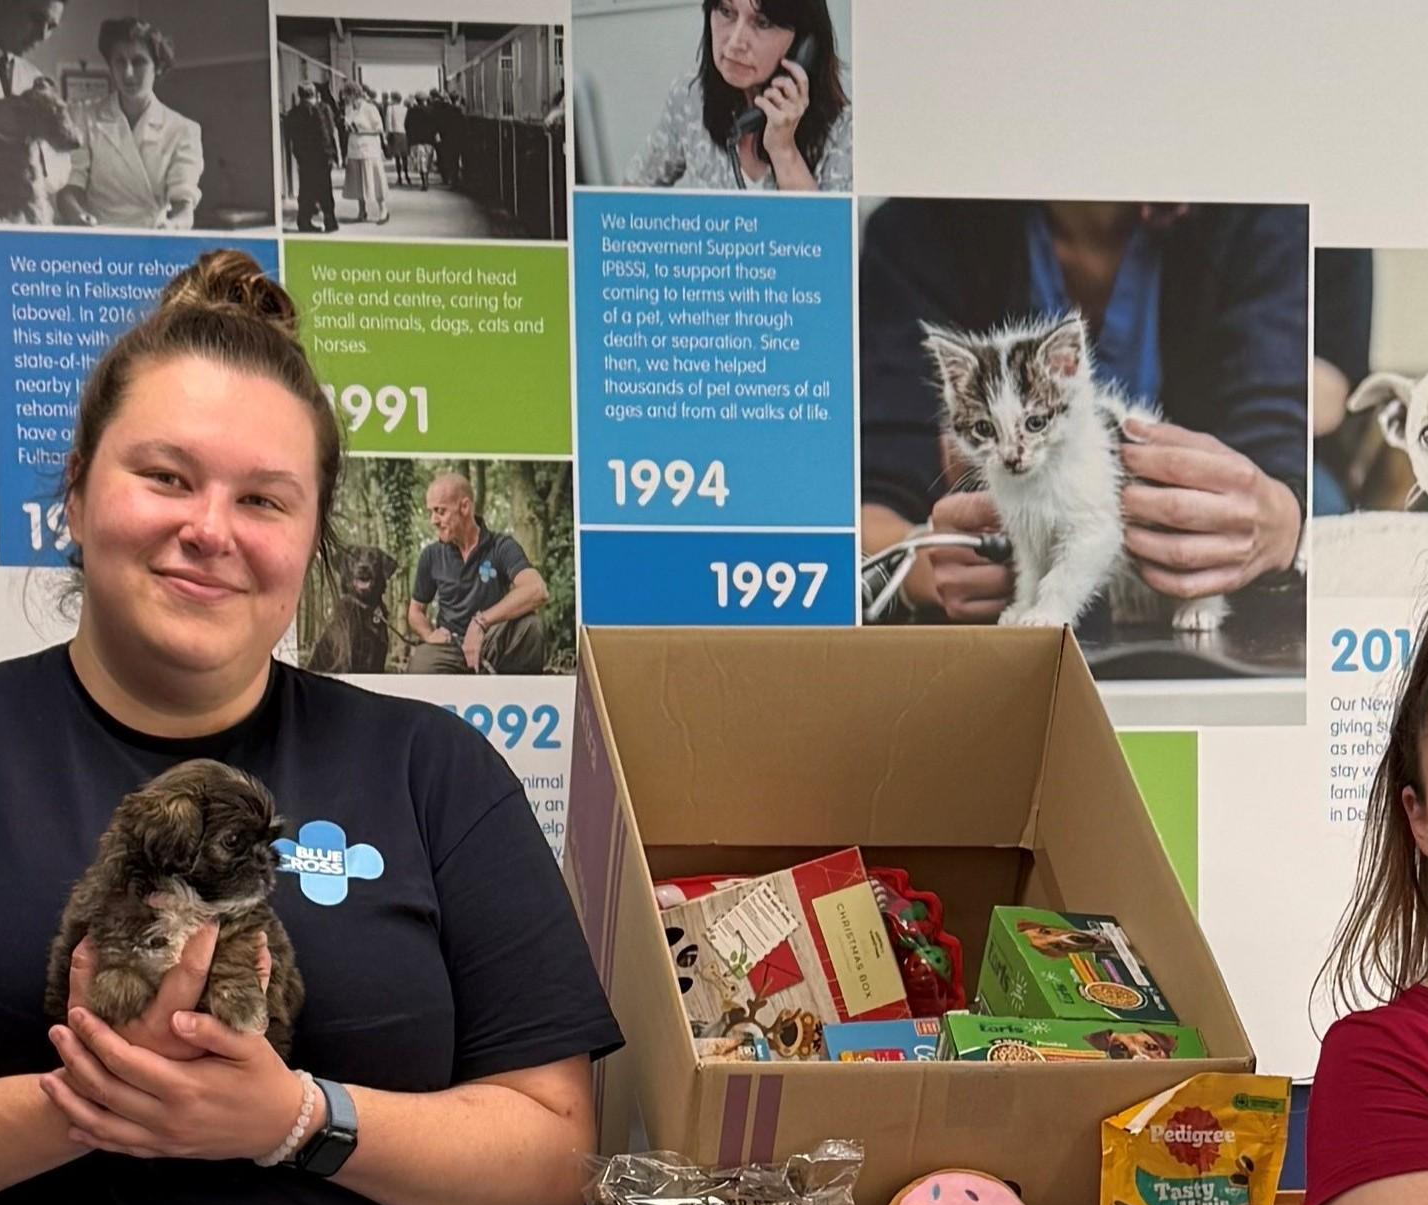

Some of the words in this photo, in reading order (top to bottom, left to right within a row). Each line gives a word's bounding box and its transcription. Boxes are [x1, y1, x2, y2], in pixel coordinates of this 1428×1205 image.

[602, 214, 626, 229] We
[630, 214, 700, 231] launched
[705, 220, 730, 232] our
[735, 217, 757, 232] Pet
[602, 237, 702, 254] Bereavement
[707, 240, 764, 259] Support
[769, 240, 821, 257] Service
[10, 256, 36, 272] We
[41, 258, 102, 276] opened
[108, 262, 133, 275] our
[312, 265, 337, 281] We
[341, 269, 381, 284] open
[386, 270, 411, 282] our
[416, 267, 472, 284] Burford
[477, 269, 516, 285] head
[602, 260, 649, 279] (PBSS),
[655, 264, 668, 277] to
[673, 264, 730, 282] support
[736, 263, 776, 280] those
[12, 282, 61, 296] centre
[66, 282, 80, 297] in
[603, 287, 659, 305] coming
[664, 287, 678, 301] to
[682, 288, 724, 302] terms
[729, 288, 760, 302] with
[765, 288, 788, 304] the
[792, 288, 821, 304] loss
[312, 289, 354, 305] office
[358, 290, 389, 306] and
[394, 293, 444, 309] centre,
[450, 296, 498, 312] caring
[504, 292, 522, 308] for
[12, 304, 74, 322] (above).
[80, 306, 93, 322] In
[99, 306, 135, 323] 2016
[314, 313, 355, 328] small
[360, 315, 425, 332] animals,
[431, 315, 472, 336] dogs,
[478, 318, 509, 332] cats
[514, 318, 544, 333] and
[14, 328, 41, 344] this
[46, 330, 73, 345] site
[77, 330, 110, 346] with
[315, 336, 369, 353] horses.
[608, 459, 730, 507] 1994
[710, 561, 828, 608] 1997
[1331, 628, 1410, 672] 201
[1330, 696, 1356, 711] Our
[1361, 697, 1393, 711] New
[441, 704, 561, 749] 992
[1330, 720, 1372, 736] giving
[1330, 743, 1347, 755] as
[1330, 764, 1359, 780] stay
[1330, 807, 1343, 821] in
[296, 845, 343, 862] BLUE
[837, 903, 864, 970] CHRISTMAS
[859, 974, 872, 998] BOX
[1150, 1124, 1236, 1148] Pedigree
[1154, 1181, 1214, 1201] Tasty
